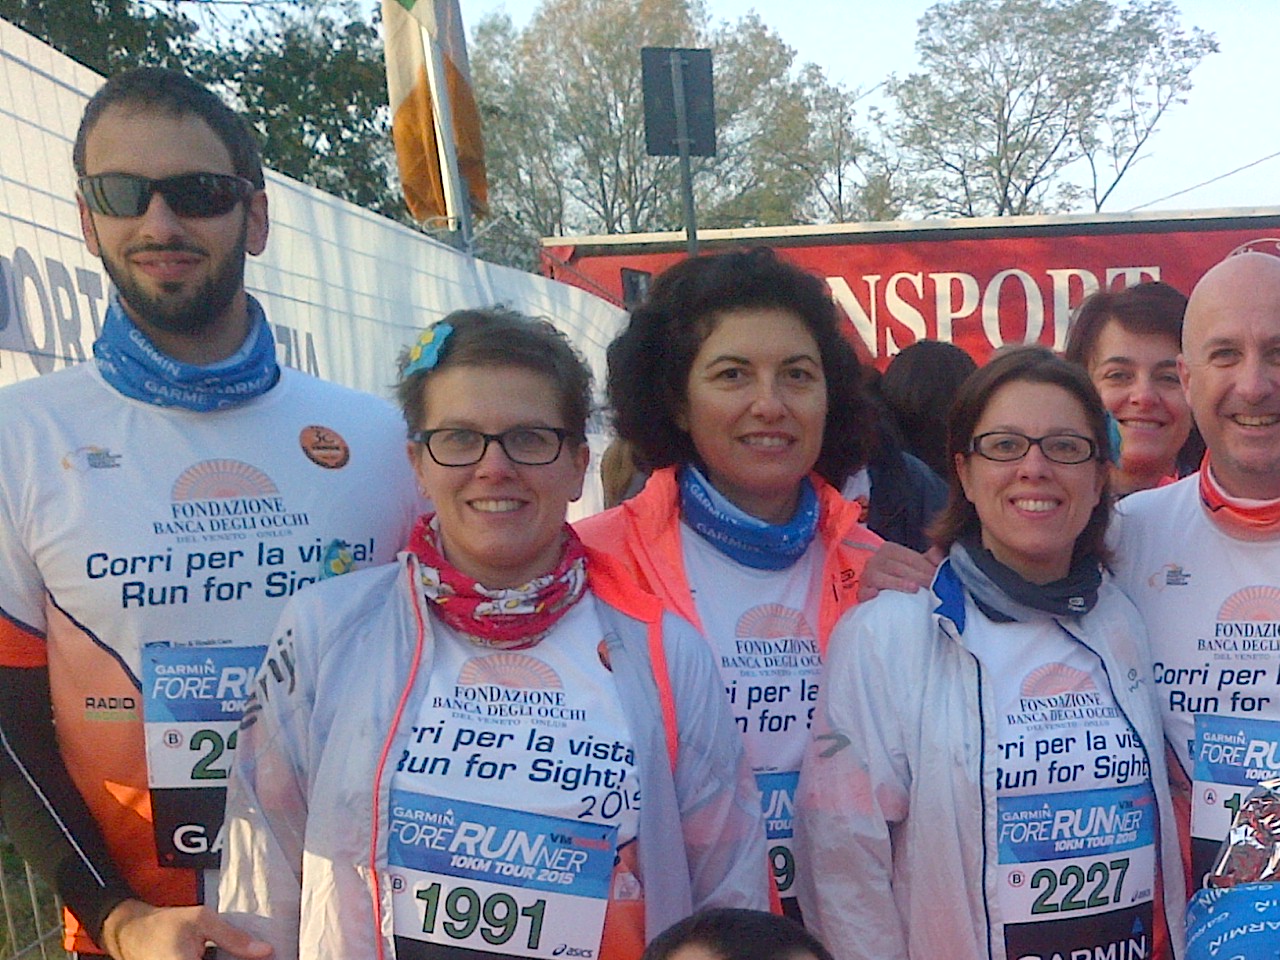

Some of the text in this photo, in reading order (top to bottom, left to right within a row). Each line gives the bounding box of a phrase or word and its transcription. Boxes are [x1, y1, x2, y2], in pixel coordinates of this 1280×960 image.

[171, 497, 286, 519] FONDAZIONE
[153, 512, 309, 535] BANCA DEGLI OCCHI
[86, 542, 285, 580] Corri per la
[122, 576, 253, 608] Run for
[1197, 638, 1238, 652] BANCA
[1242, 638, 1280, 652] DEGLI
[155, 664, 216, 676] GARMIN
[721, 655, 798, 669] BANCA DEGLI
[1153, 661, 1210, 686] Corri
[1217, 666, 1267, 691] per
[85, 697, 135, 710] RADIO
[454, 685, 566, 707] FONDAZIONE
[747, 684, 792, 709] per
[1020, 692, 1102, 713] FONDAZIONE
[1169, 690, 1218, 712] Run
[1230, 690, 1270, 712] for
[432, 696, 587, 722] BANCA DEGLI OCCHI
[1007, 709, 1048, 725] BANCA
[1050, 707, 1084, 721] DEGLI
[759, 709, 797, 733] for
[452, 727, 635, 768] per la vista
[1035, 730, 1107, 762] per la
[1203, 731, 1247, 745] GARMIN
[464, 753, 518, 781] for
[528, 757, 627, 791] Sight!
[1048, 760, 1085, 784] for
[392, 806, 455, 825] GARMIN
[1002, 808, 1051, 822] GARMIN
[1054, 840, 1084, 852] 10KM
[1087, 835, 1114, 848] TOUR
[451, 855, 575, 885] 10KM TOUR 2015
[1030, 857, 1130, 915] 2227
[416, 882, 547, 950] 1991
